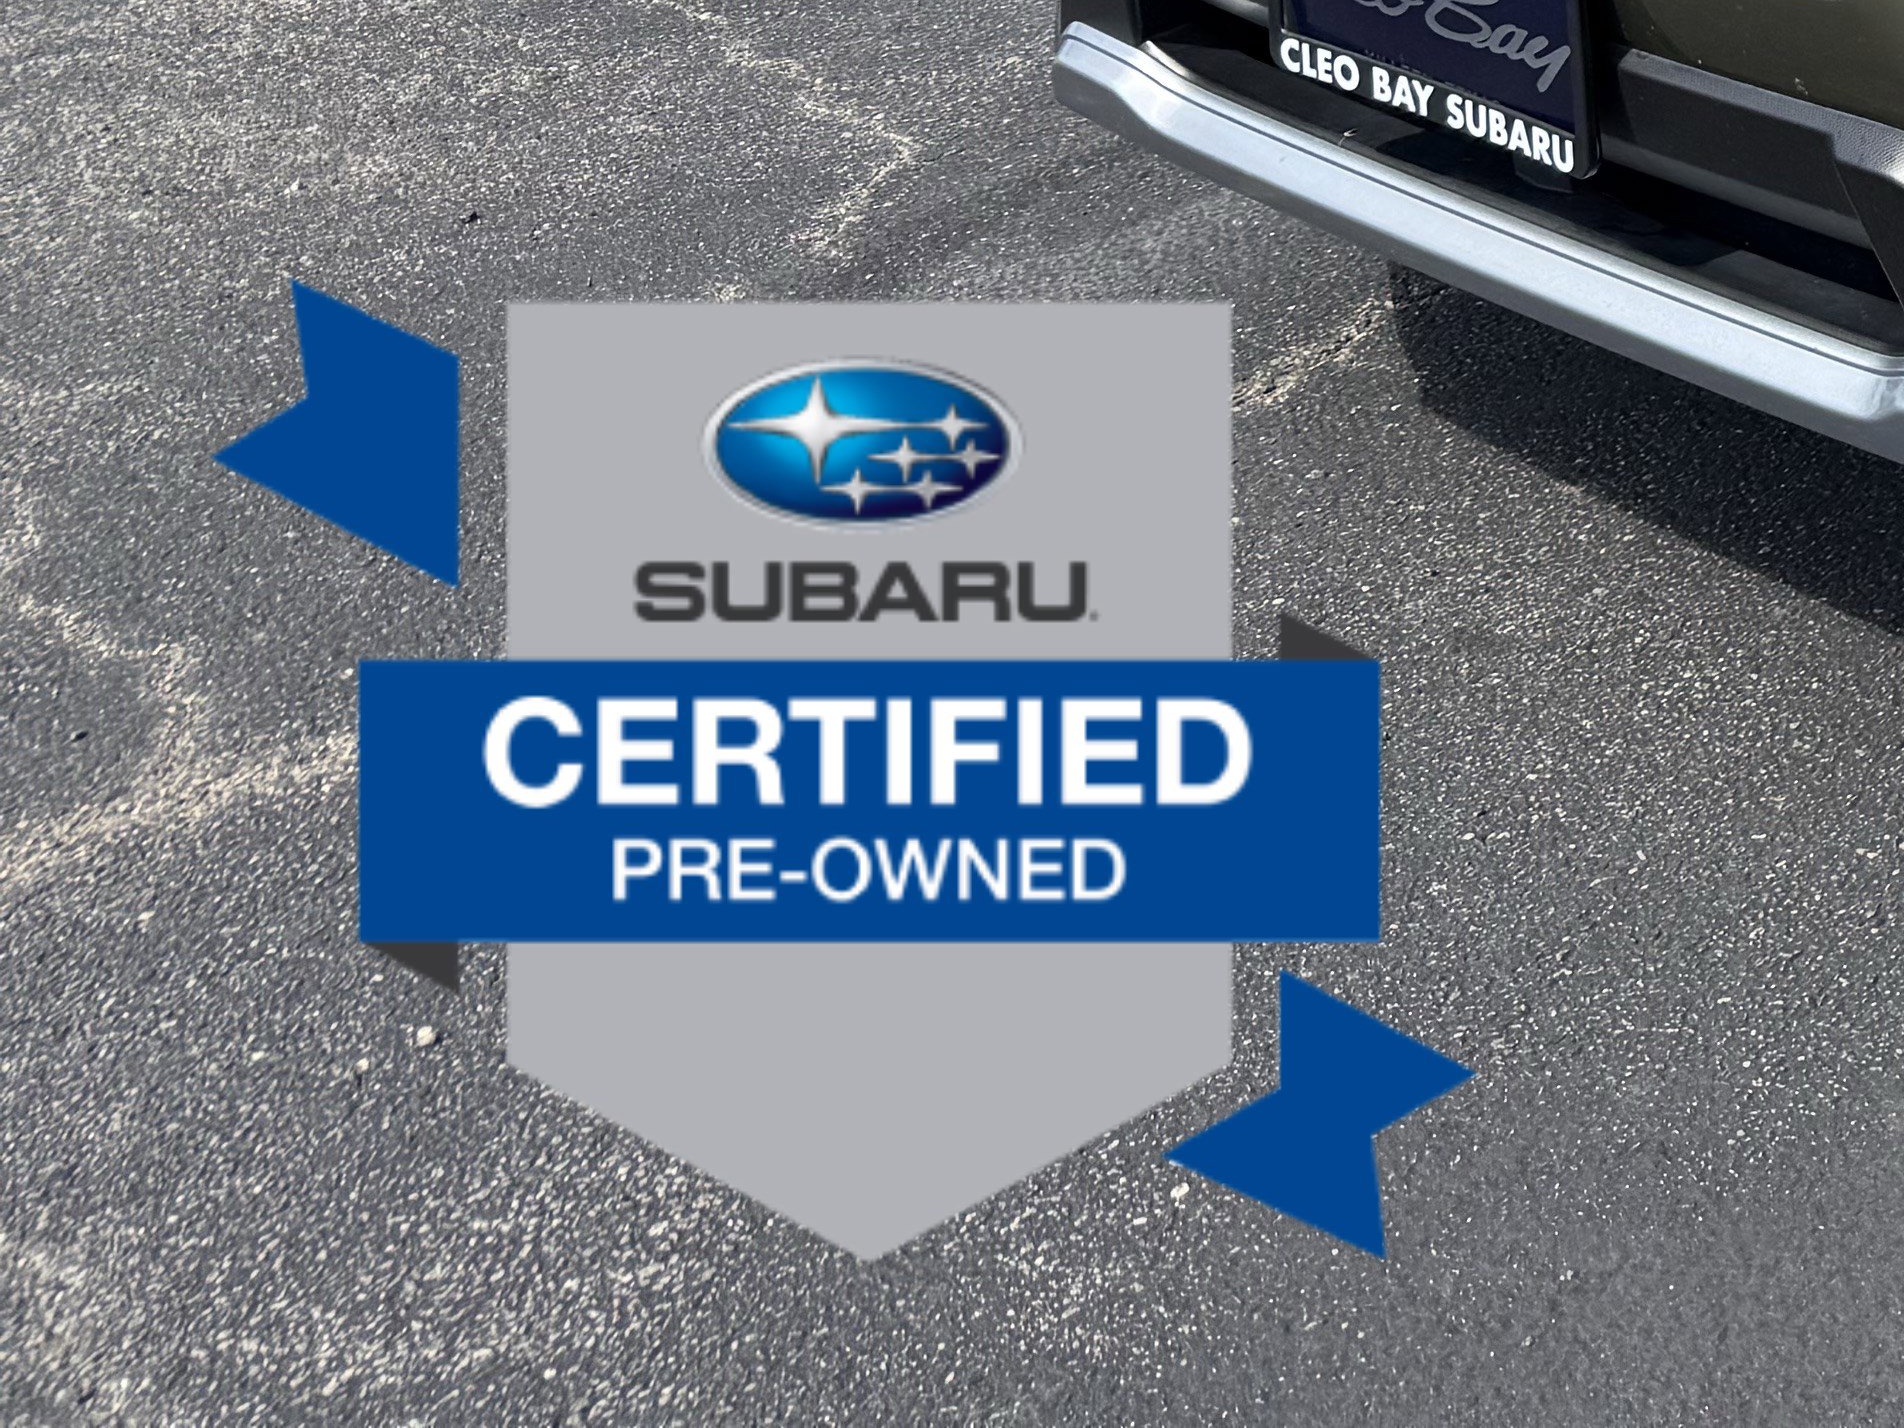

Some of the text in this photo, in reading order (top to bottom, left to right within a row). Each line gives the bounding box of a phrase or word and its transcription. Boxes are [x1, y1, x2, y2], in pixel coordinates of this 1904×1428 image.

[1280, 37, 1360, 92] CLEO
[1371, 66, 1435, 118] BAY
[1446, 93, 1574, 174] SUBARU
